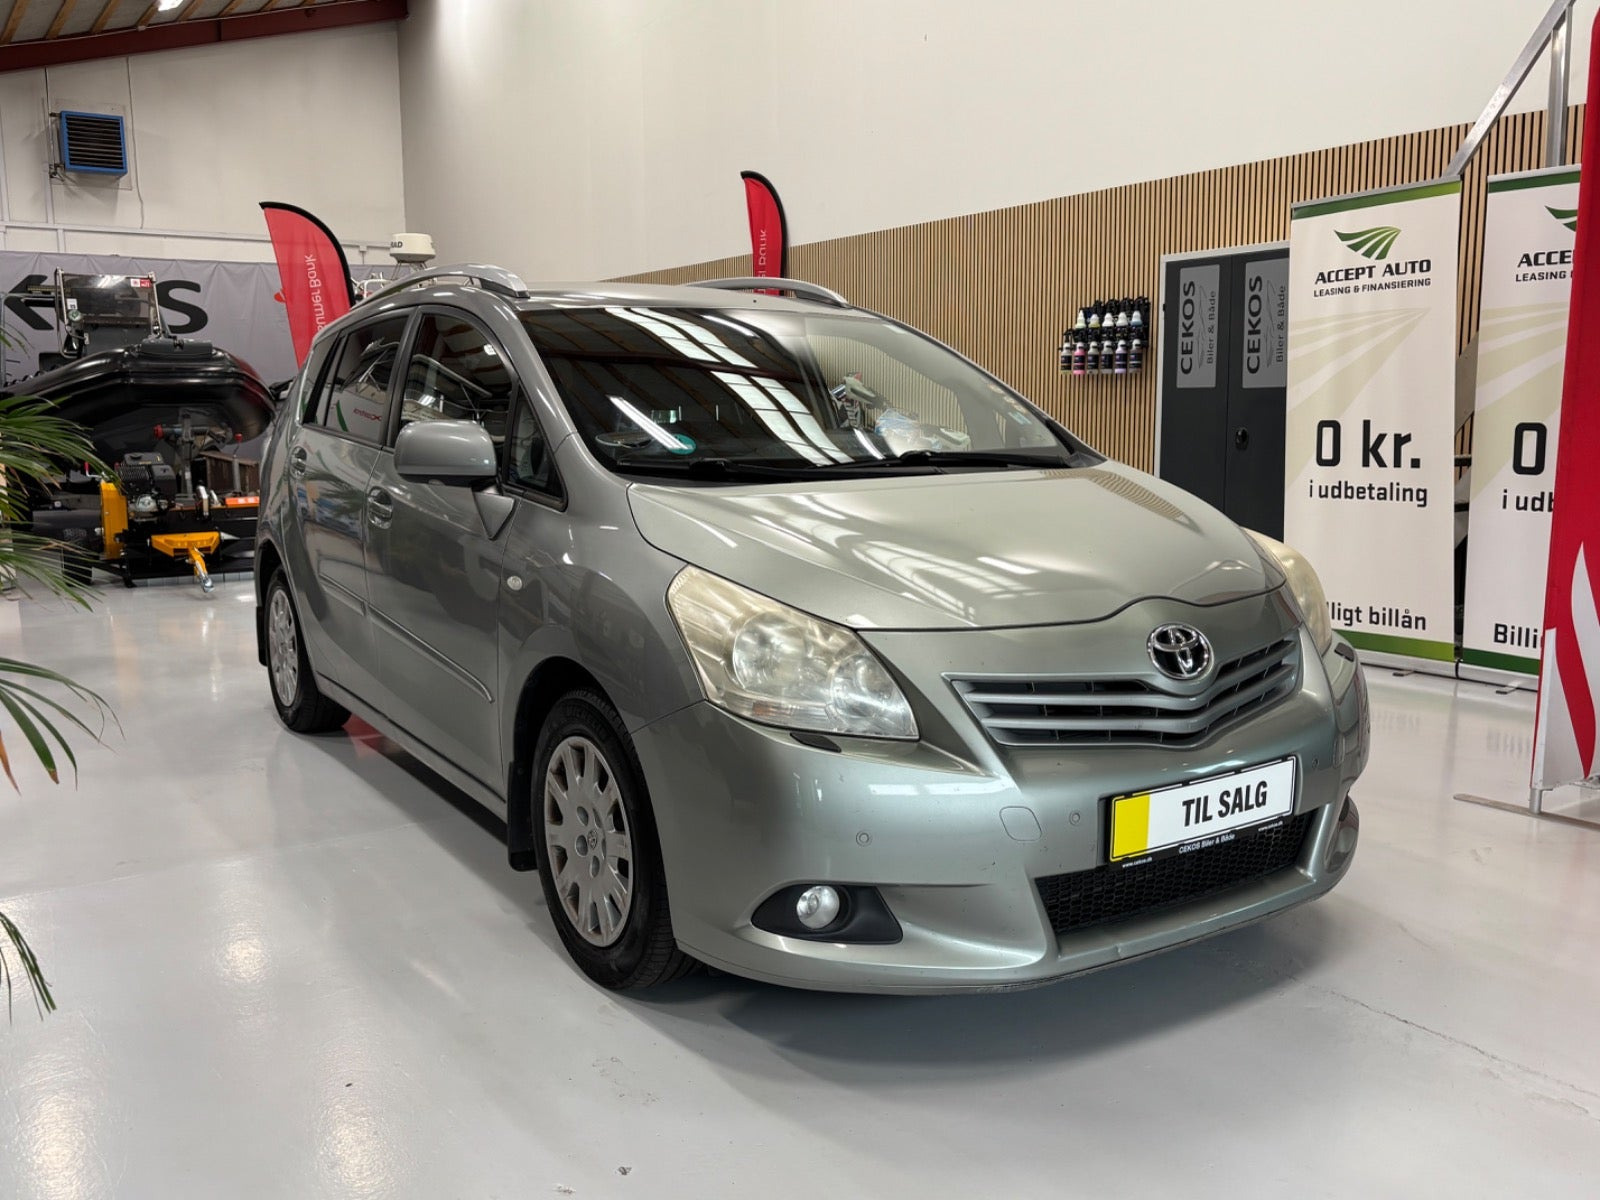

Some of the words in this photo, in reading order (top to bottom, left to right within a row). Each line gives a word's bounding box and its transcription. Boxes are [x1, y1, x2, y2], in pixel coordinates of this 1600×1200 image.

[1517, 249, 1574, 268] ACCE
[1315, 265, 1376, 285] ACCEPT
[1382, 259, 1431, 277] AUTO
[1515, 270, 1567, 282] LEASING
[1314, 285, 1351, 298] LEASING
[1353, 285, 1361, 294] &
[1362, 277, 1431, 293] FINANSIERING
[1208, 291, 1216, 320] Både
[1277, 285, 1286, 317] Både
[1180, 280, 1195, 375] CEKOS
[1208, 325, 1215, 334] &
[1247, 275, 1262, 375] CEKOS
[1277, 321, 1285, 331] &
[1206, 339, 1215, 365] Biler
[1276, 336, 1284, 363] Biler
[1316, 420, 1341, 467] 0
[1361, 419, 1421, 469] kr.
[1512, 422, 1547, 476] 0
[1309, 479, 1314, 498] i
[1318, 481, 1428, 508] udbetaling
[1502, 488, 1508, 510] i
[1369, 606, 1427, 631] billån
[1182, 795, 1213, 828] TIL
[1218, 780, 1267, 818] SALG
